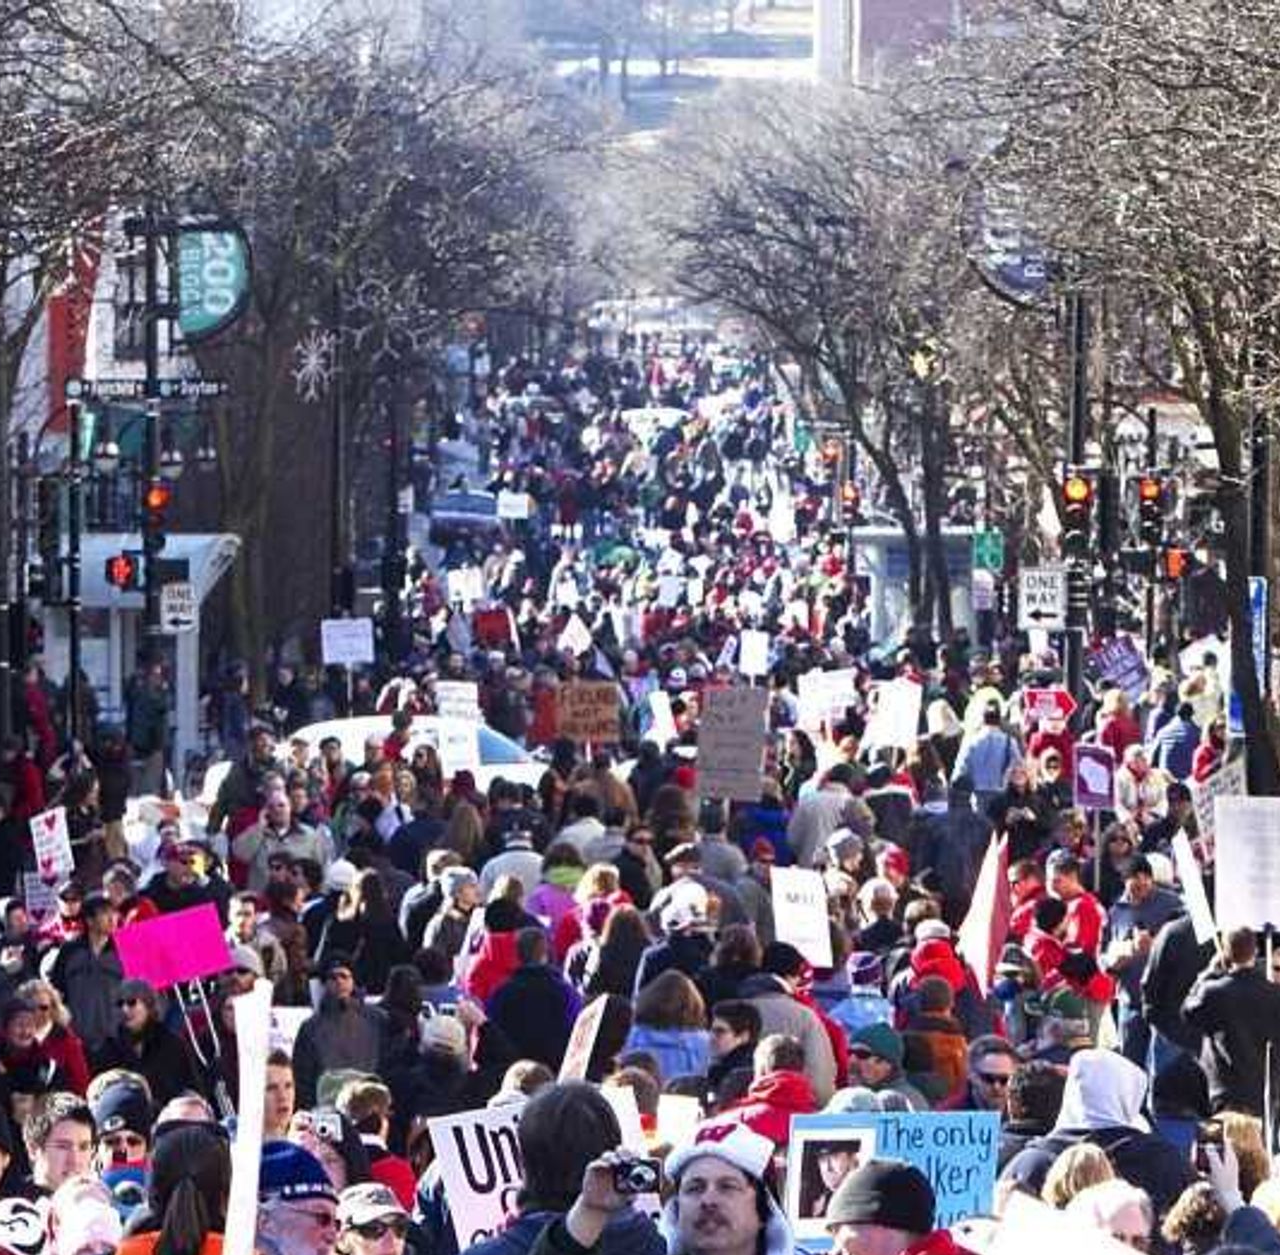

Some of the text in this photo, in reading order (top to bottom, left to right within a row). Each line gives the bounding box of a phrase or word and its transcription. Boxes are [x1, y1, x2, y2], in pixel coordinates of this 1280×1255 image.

[1025, 575, 1058, 589] ONE
[1025, 592, 1058, 606] WAY
[878, 1116, 992, 1162] The only
